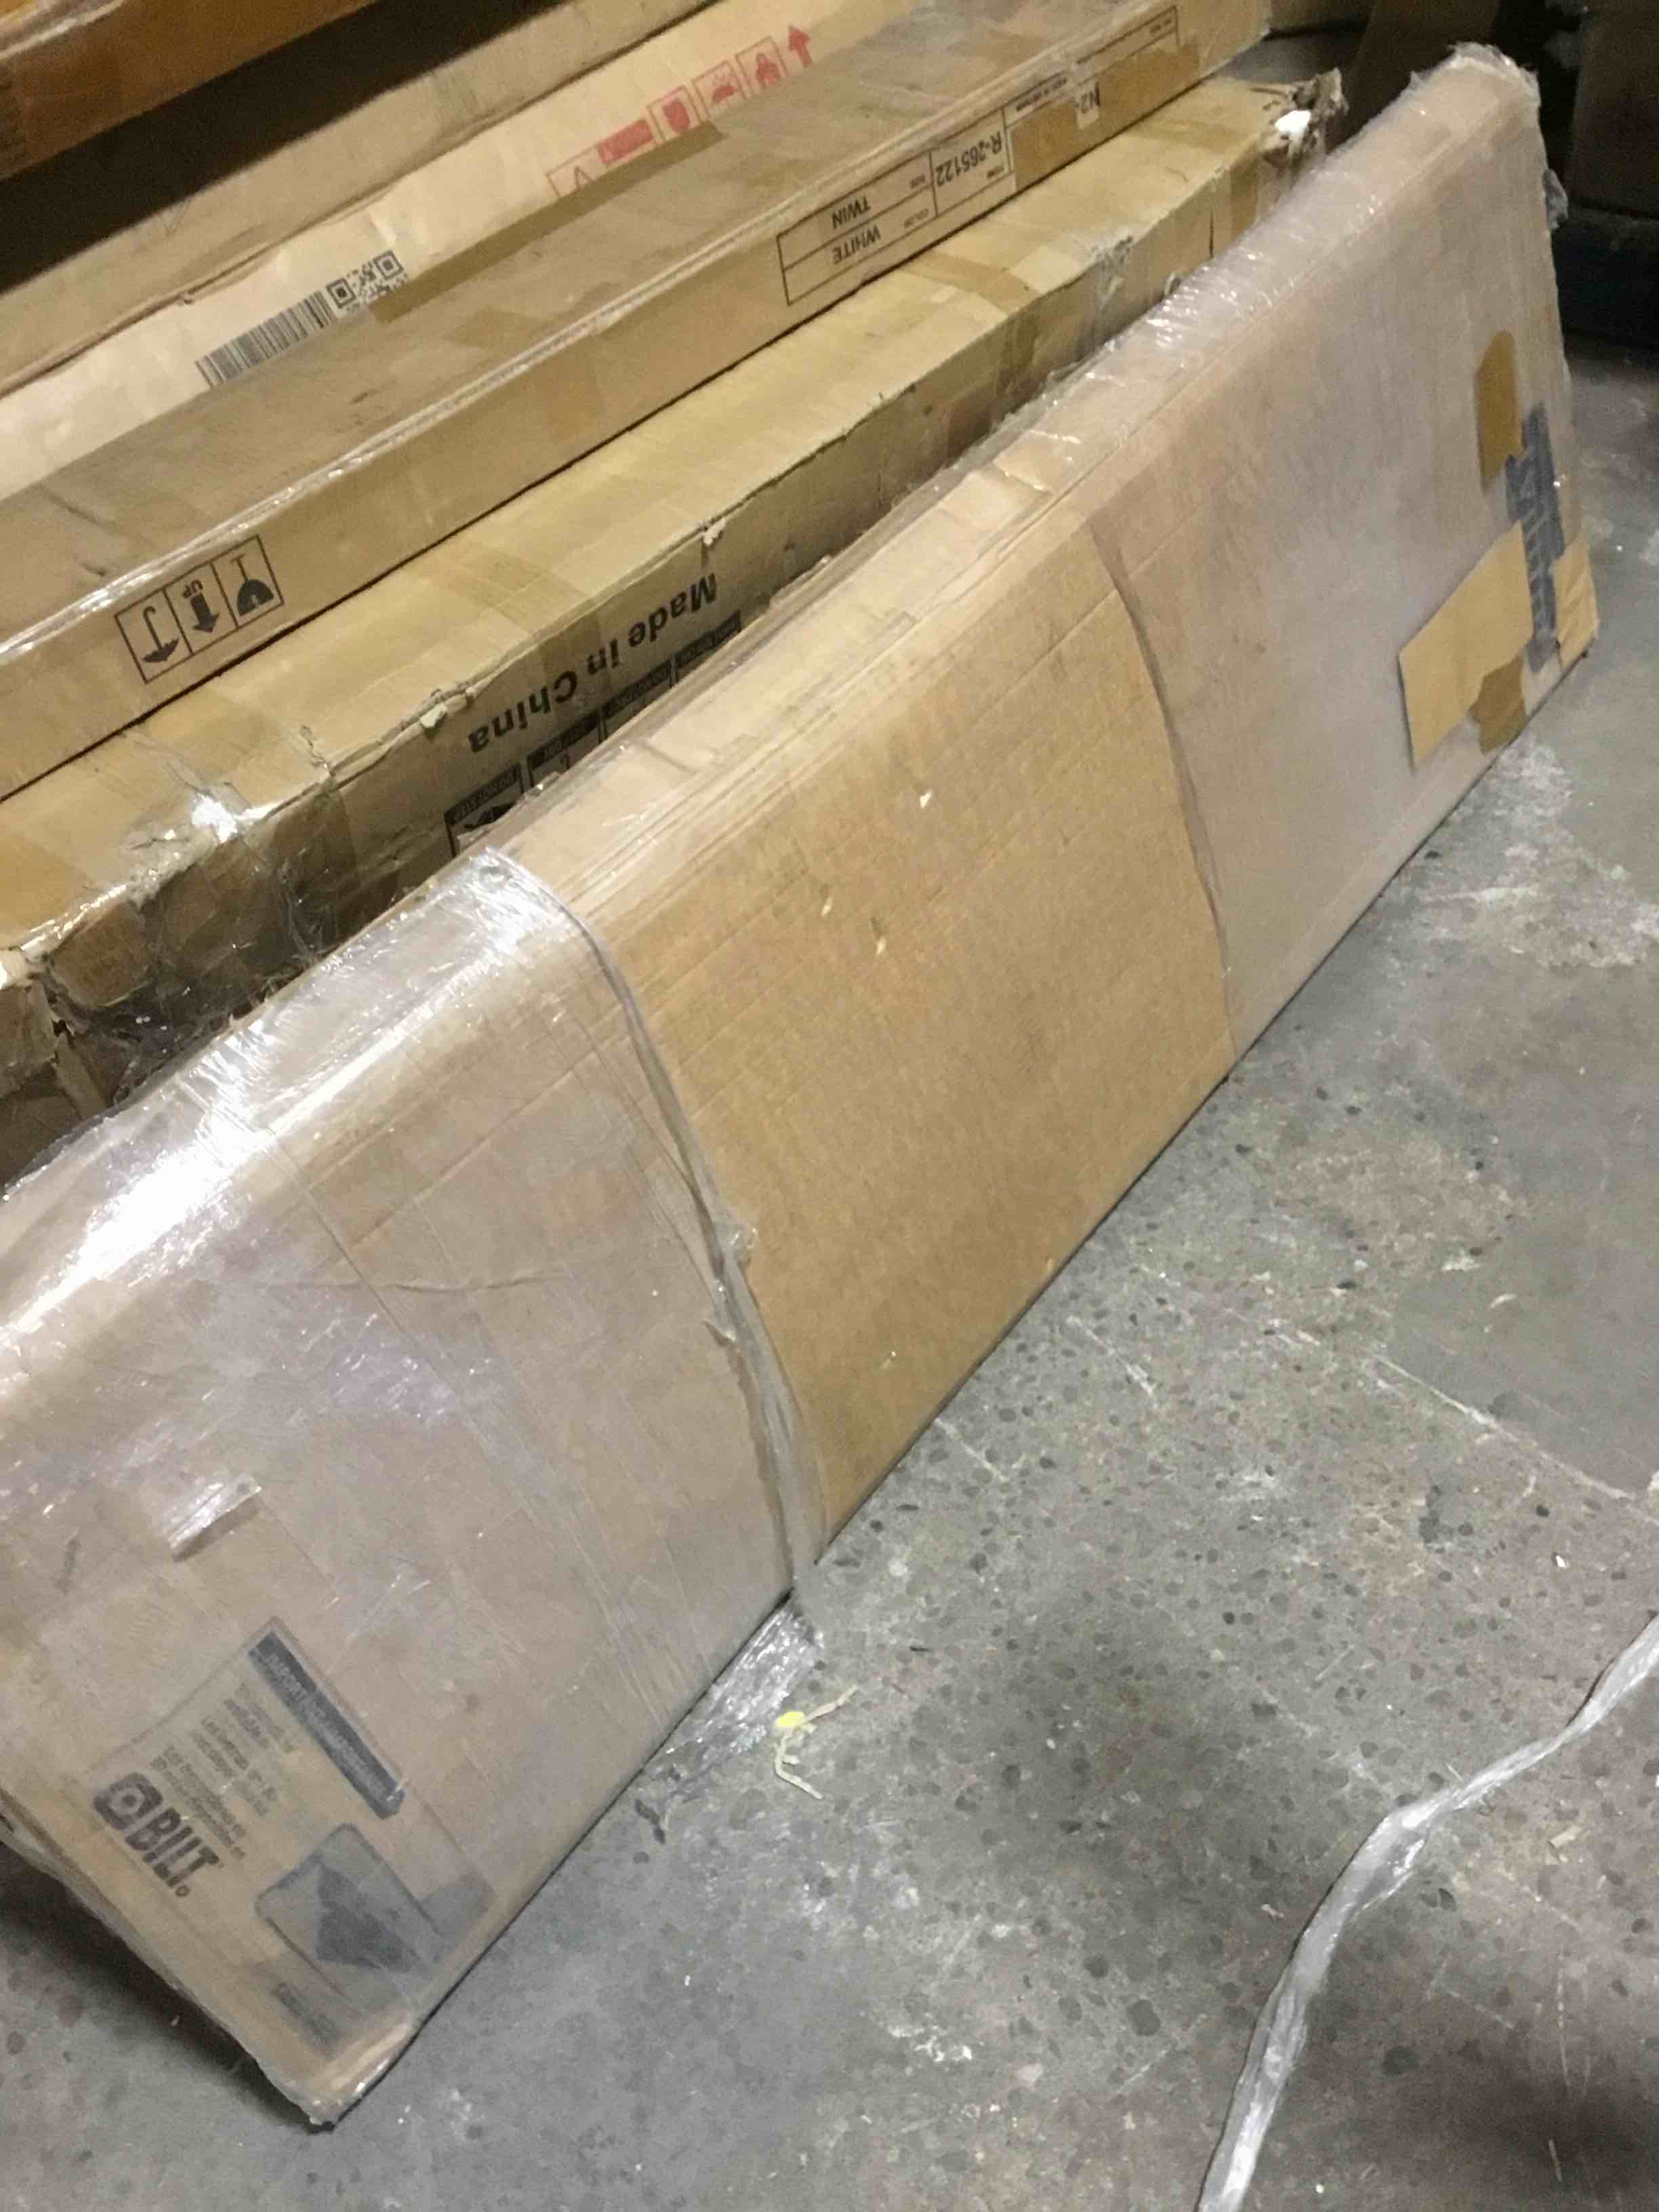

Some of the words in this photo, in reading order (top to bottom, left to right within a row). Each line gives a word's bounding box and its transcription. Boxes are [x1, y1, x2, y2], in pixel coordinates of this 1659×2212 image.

[832, 195, 871, 230] TWIN
[833, 225, 881, 265] WHITE
[182, 579, 203, 598] UP
[628, 573, 717, 648] Made
[586, 638, 619, 675] in
[468, 670, 577, 753] China
[125, 1808, 220, 1889] BILT
